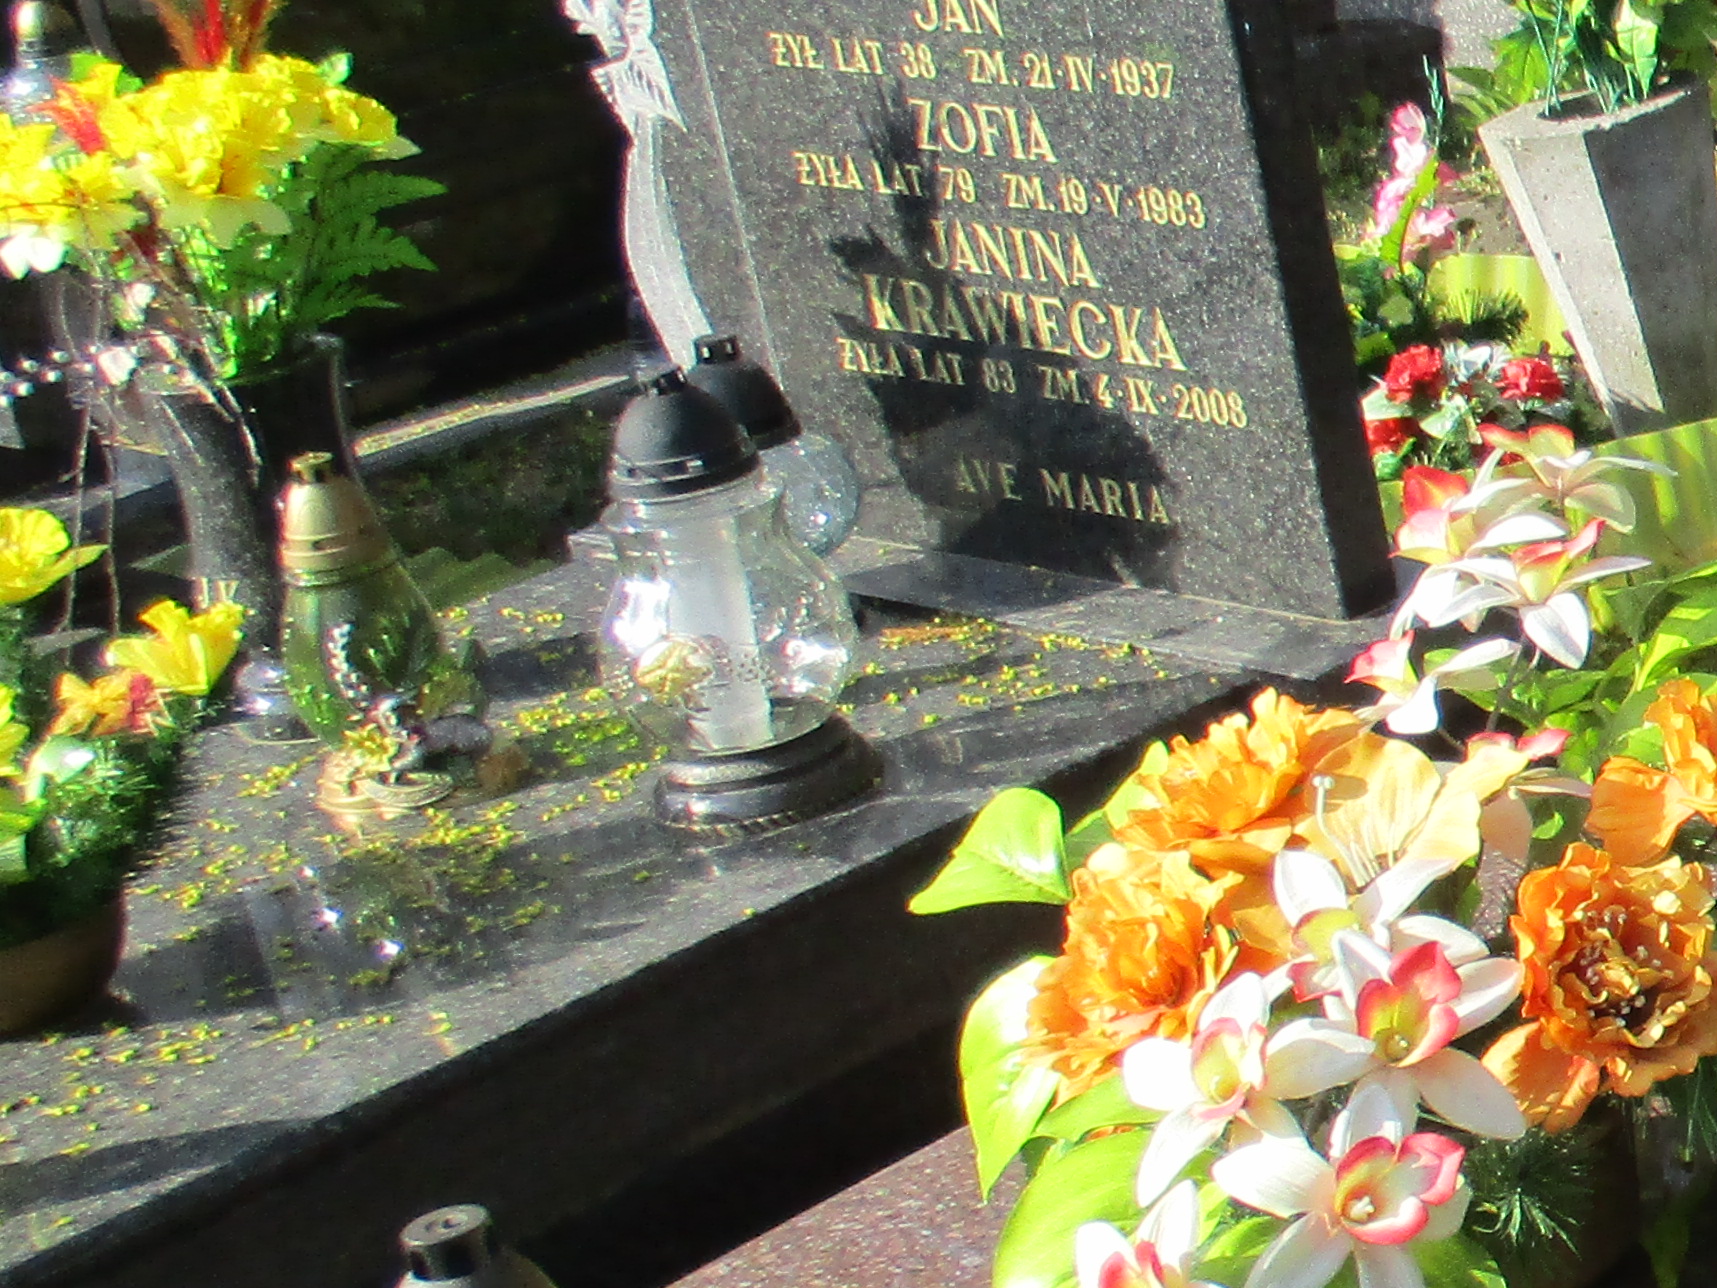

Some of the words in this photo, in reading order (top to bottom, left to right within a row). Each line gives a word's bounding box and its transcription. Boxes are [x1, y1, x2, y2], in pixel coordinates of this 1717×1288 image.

[830, 37, 885, 75] LAT
[901, 41, 937, 79] 38
[906, 97, 1058, 163] ZOFIA
[869, 159, 923, 197] LAT
[936, 163, 976, 203] 79
[925, 218, 1101, 289] JANINA
[863, 272, 1189, 372] KRAWIECKA
[907, 347, 965, 386] LAT
[981, 357, 1017, 395] 83
[954, 452, 1022, 502] AVE
[1038, 467, 1171, 526] MARIA
